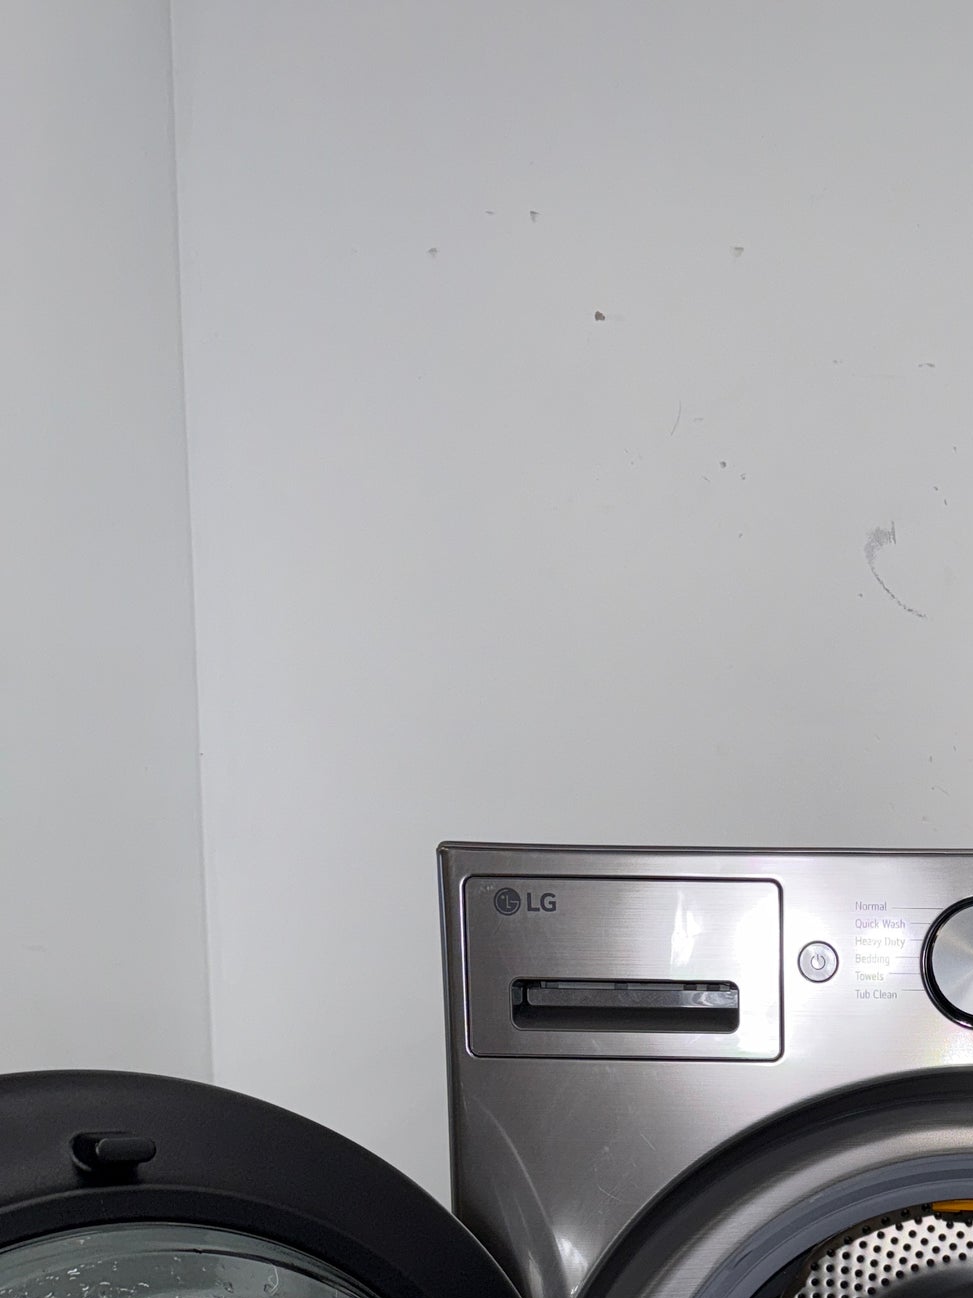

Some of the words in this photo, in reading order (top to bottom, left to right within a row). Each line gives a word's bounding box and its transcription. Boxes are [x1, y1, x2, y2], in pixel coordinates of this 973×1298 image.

[527, 892, 557, 912] LG
[855, 901, 887, 911] Normal
[855, 919, 880, 929] Quick
[882, 919, 906, 929] Wash
[855, 936, 881, 948] Heavy
[884, 937, 906, 949] Duty
[855, 954, 890, 966] Bedding
[855, 971, 884, 981] Towels
[855, 989, 871, 999] Tub
[873, 989, 898, 999] Clean
